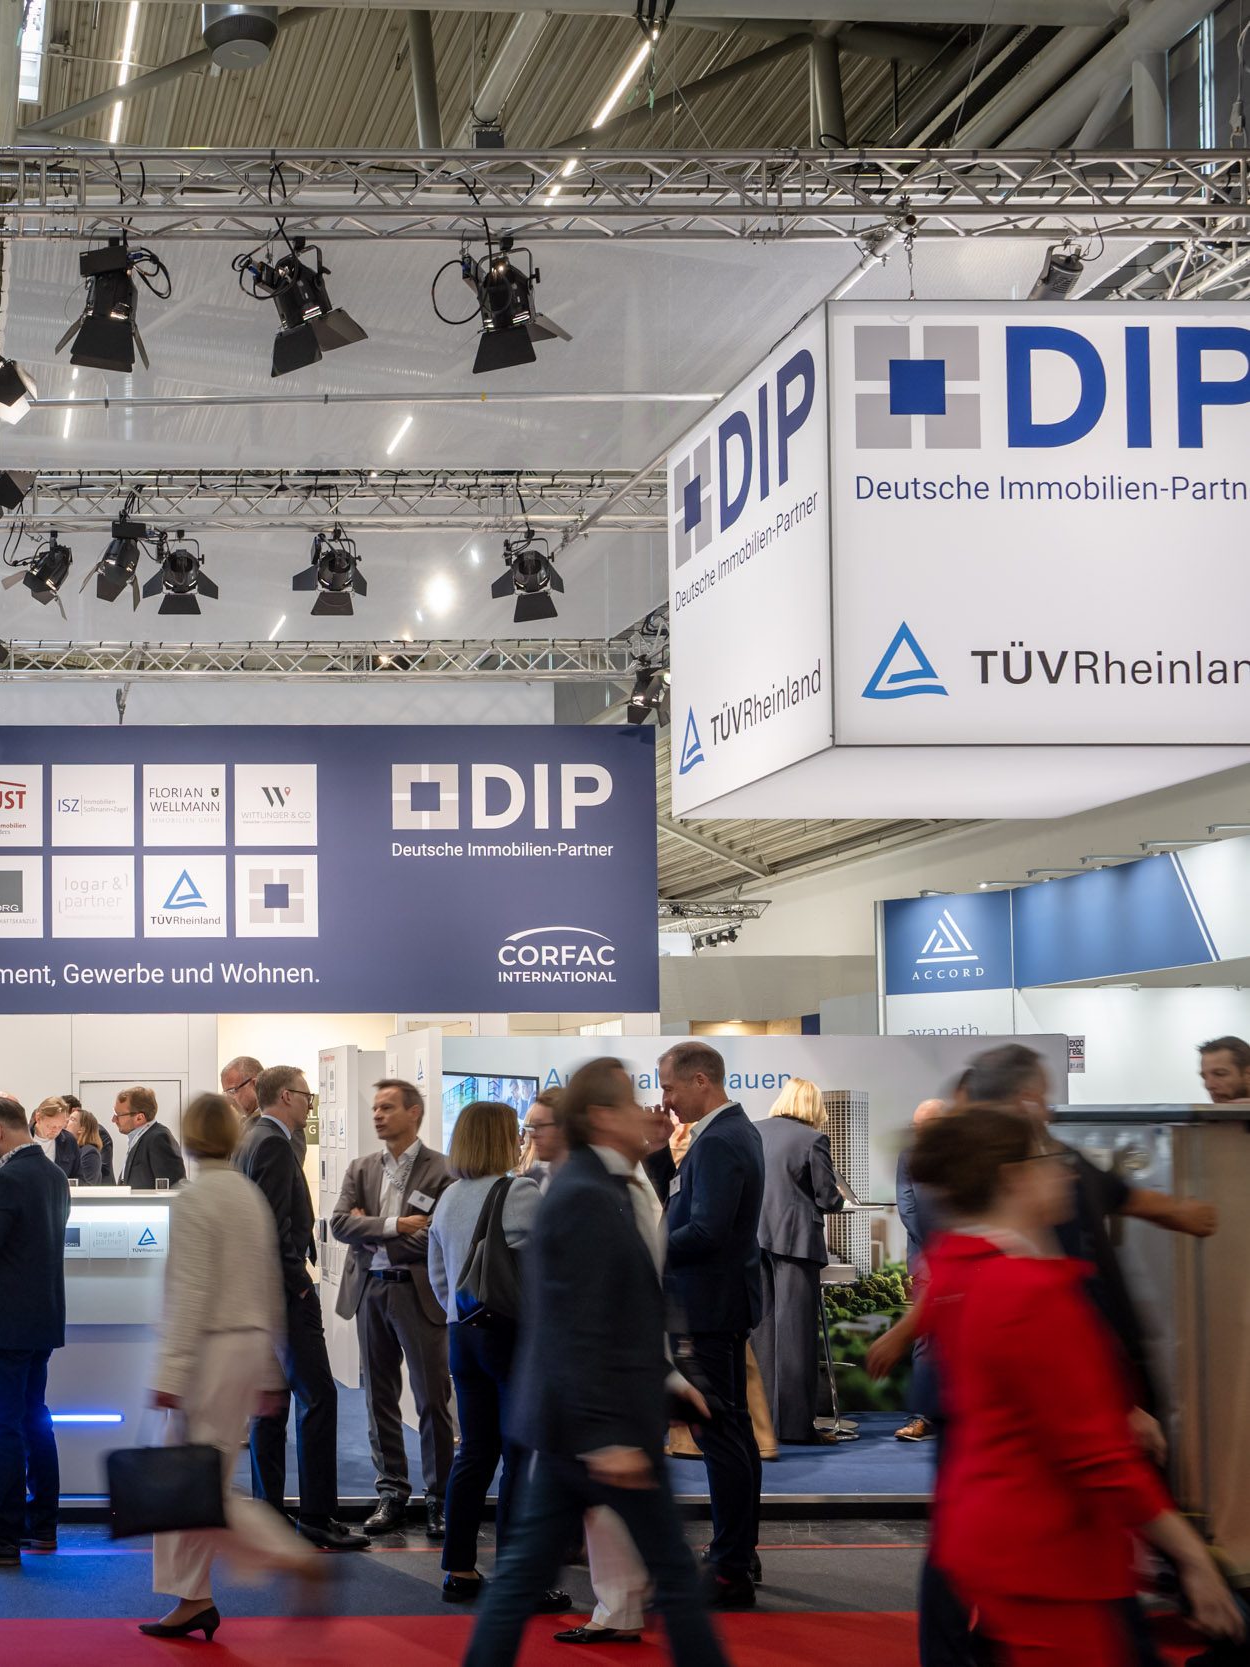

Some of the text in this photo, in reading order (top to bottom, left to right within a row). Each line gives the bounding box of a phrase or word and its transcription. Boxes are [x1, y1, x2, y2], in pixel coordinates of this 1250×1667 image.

[1006, 325, 1250, 449] DIP
[719, 348, 816, 534] DIP
[856, 475, 990, 501] Deutsche
[675, 490, 819, 613] Deutsche Immobilien-Partner
[710, 658, 823, 747] TÜVRheinland
[149, 787, 203, 798] FLORIAN
[472, 764, 613, 829] DIP
[57, 799, 80, 813] ISZ
[150, 801, 220, 812] WELLMANN
[241, 811, 312, 819] WITTLINGER & CO
[392, 842, 613, 857] Deutsche Immobilien-Partner
[64, 877, 123, 894] logar &
[64, 895, 120, 910] partner
[151, 915, 221, 925] TÜVRheinland
[498, 945, 616, 966] CORFAC
[63, 964, 165, 984] Gewerbe
[171, 963, 214, 984] und
[220, 963, 321, 984] Wohnen.
[498, 971, 617, 983] INTERNATIONAL
[912, 967, 985, 981] ACCORD
[724, 1073, 791, 1089] auen
